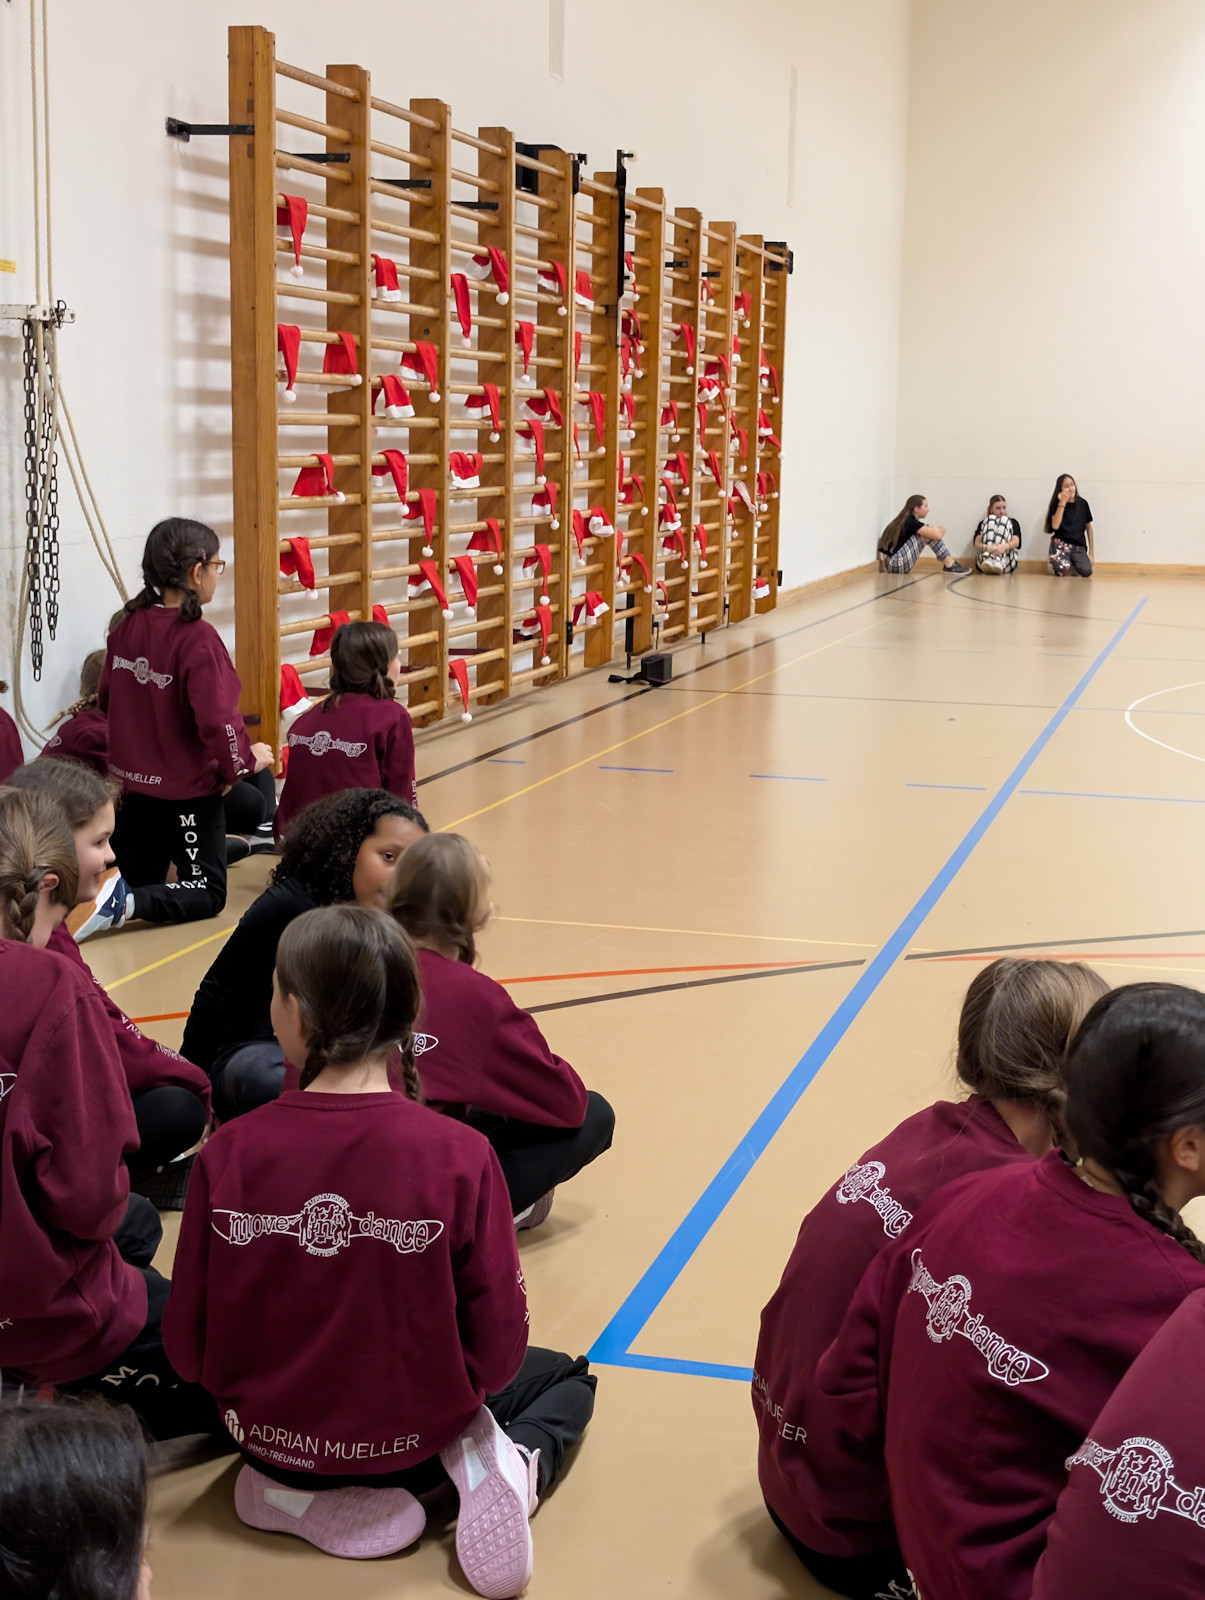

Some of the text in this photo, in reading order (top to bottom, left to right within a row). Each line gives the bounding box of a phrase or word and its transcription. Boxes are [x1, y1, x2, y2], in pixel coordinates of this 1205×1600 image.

[125, 771, 163, 785] MUELLER
[179, 813, 203, 876] MOVE
[304, 1193, 350, 1209] TURNVEREIN
[870, 1187, 913, 1236] danc
[228, 1213, 289, 1244] move
[359, 1211, 428, 1253] dance
[306, 1246, 339, 1257] MUTTENZ
[964, 1313, 1030, 1386] dance
[247, 1442, 315, 1469] IMMO-TREUHAND
[249, 1424, 420, 1460] ADRIAN MUELLER
[1122, 1437, 1174, 1469] TURNVEREIN
[1102, 1499, 1139, 1523] MUTTENZ
